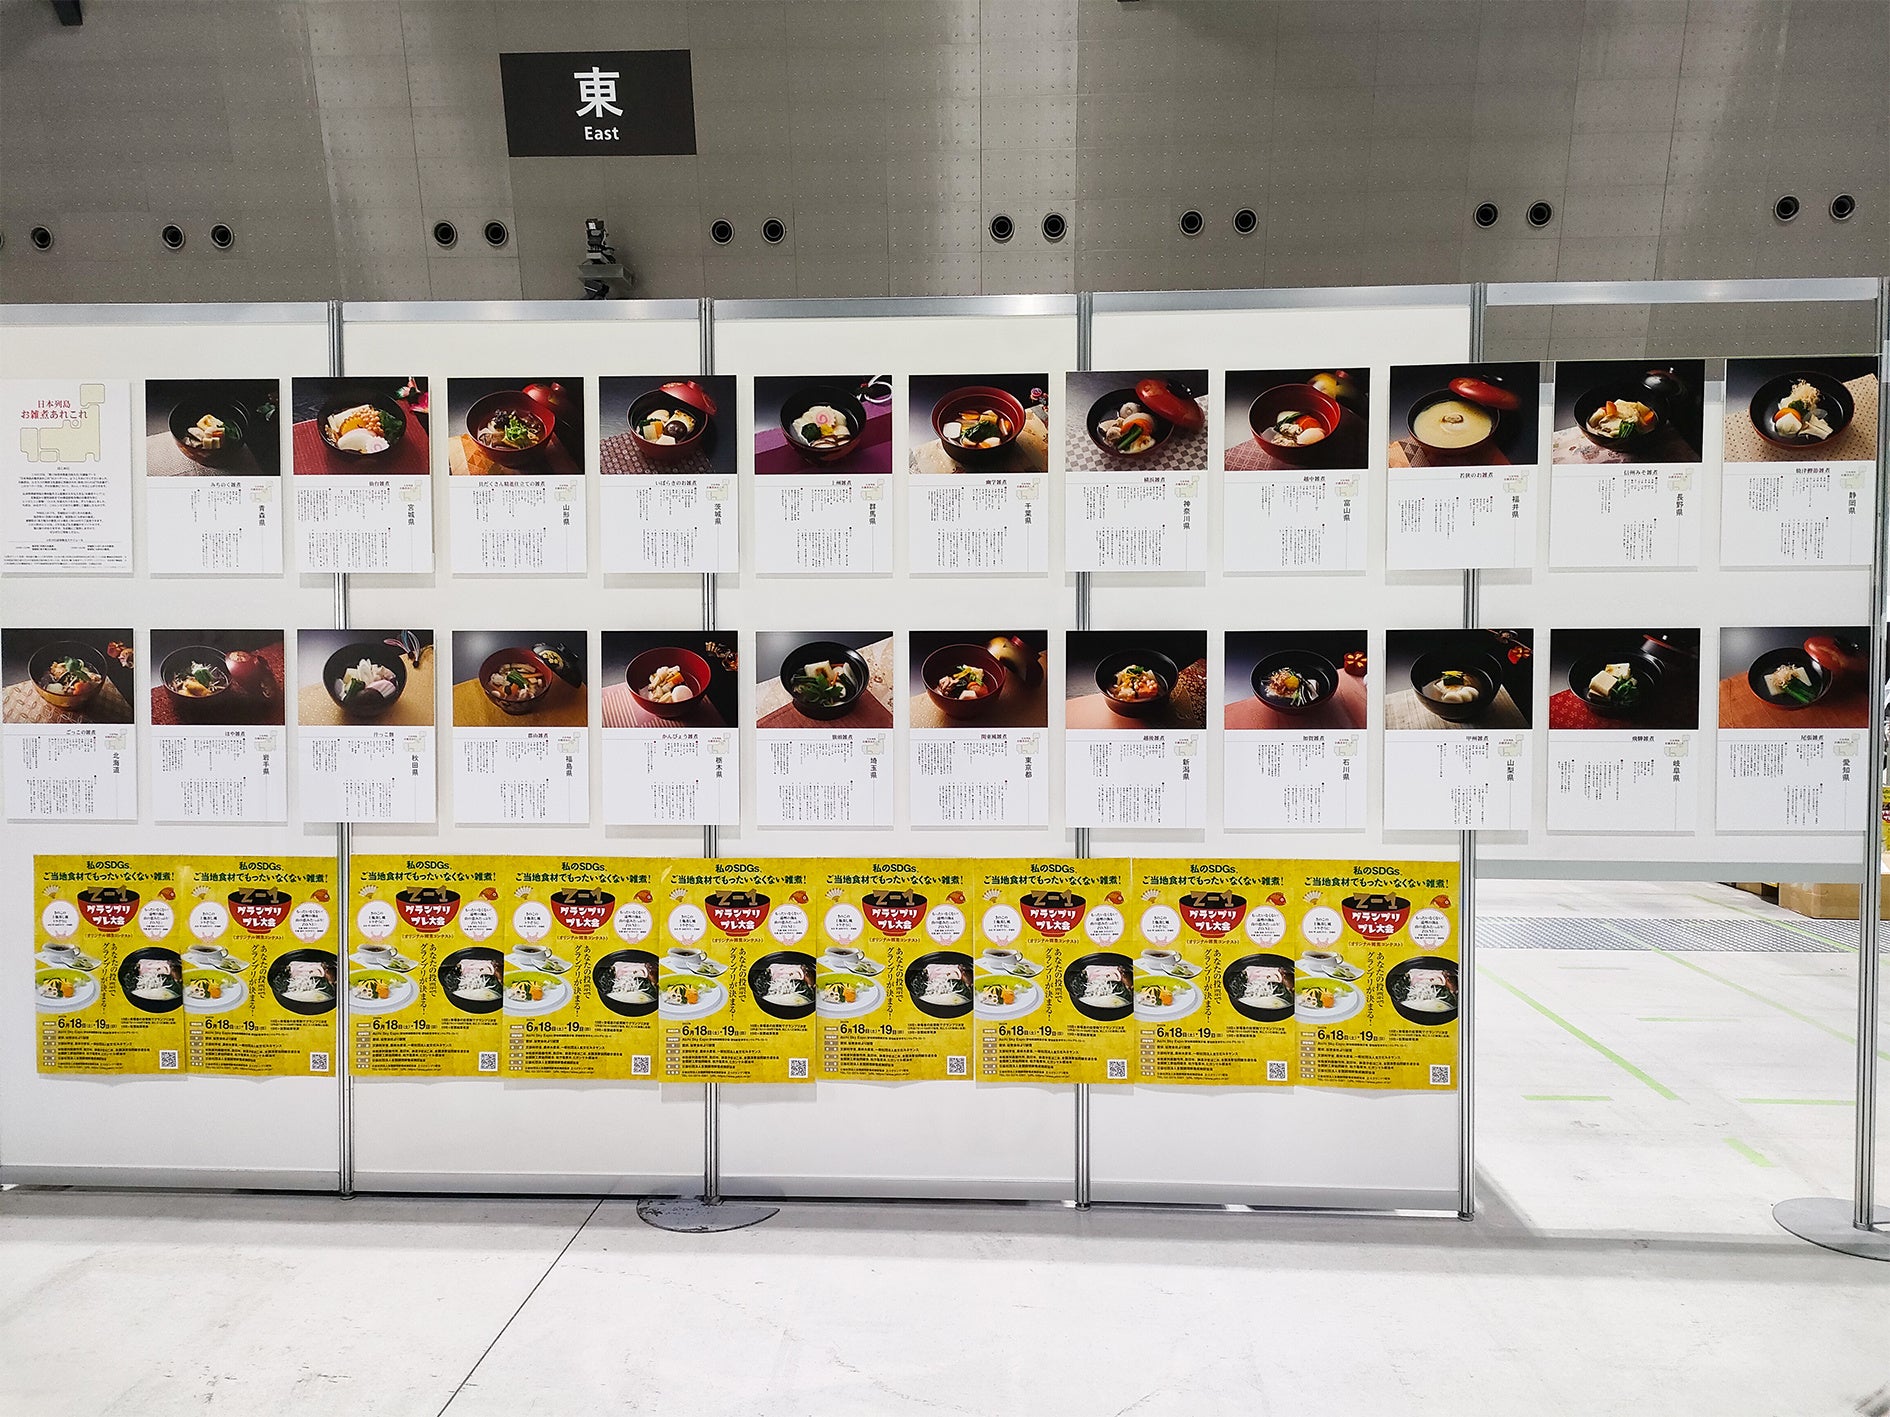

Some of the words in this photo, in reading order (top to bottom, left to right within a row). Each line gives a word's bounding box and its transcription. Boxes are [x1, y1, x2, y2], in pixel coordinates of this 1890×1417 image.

[574, 66, 624, 118] 東
[584, 126, 620, 140] East
[37, 399, 71, 409] 日本列島
[20, 410, 88, 420] お雑煮あれこれ
[1343, 499, 1351, 522] 富山県
[1511, 495, 1520, 519] 福井県
[1676, 493, 1684, 516] 長野県
[1848, 491, 1856, 515] 静岡県
[407, 503, 415, 525] 宮城県
[562, 504, 570, 525] 山形県
[714, 503, 722, 525] 茨城県
[869, 503, 877, 525] 群馬県
[1024, 503, 1032, 525] 千葉県
[1182, 500, 1190, 530] 神奈川県
[112, 752, 120, 774] 北海道
[411, 754, 419, 776] 秋田県
[565, 755, 573, 777] 福島県
[1024, 756, 1032, 778] 東京都
[1506, 759, 1515, 782] 山梨県
[1672, 760, 1680, 782] 岐阜県
[1842, 759, 1850, 782] 愛知県
[88, 885, 127, 902] Z-1
[238, 886, 279, 904] Z-1
[407, 885, 448, 902] Z-1
[562, 886, 603, 904] Z-1
[716, 888, 758, 906] Z-1
[873, 888, 914, 906] Z-1
[1031, 889, 1073, 906] Z-1
[1190, 890, 1233, 907] Z-1
[1353, 891, 1397, 909] Z-1
[87, 904, 130, 915] グランプリ
[237, 906, 282, 916] グランプリ
[406, 904, 451, 915] グランプリ
[560, 906, 606, 917] グランプリ
[715, 908, 761, 919] グランプリ
[872, 908, 918, 919] グランプリ
[1030, 909, 1076, 920] グランプリ
[1189, 909, 1237, 920] グランプリ
[1352, 911, 1400, 923] グランプリ
[93, 916, 125, 926] プレ大会
[243, 917, 276, 927] プレ大会
[412, 916, 445, 926] プレ大会
[566, 917, 600, 928] プレ大会
[721, 920, 755, 930] プレ大会
[878, 919, 912, 930] プレ大会
[1036, 920, 1071, 931] プレ大会
[1196, 921, 1231, 931] プレ大会
[1358, 923, 1394, 934] プレ大会
